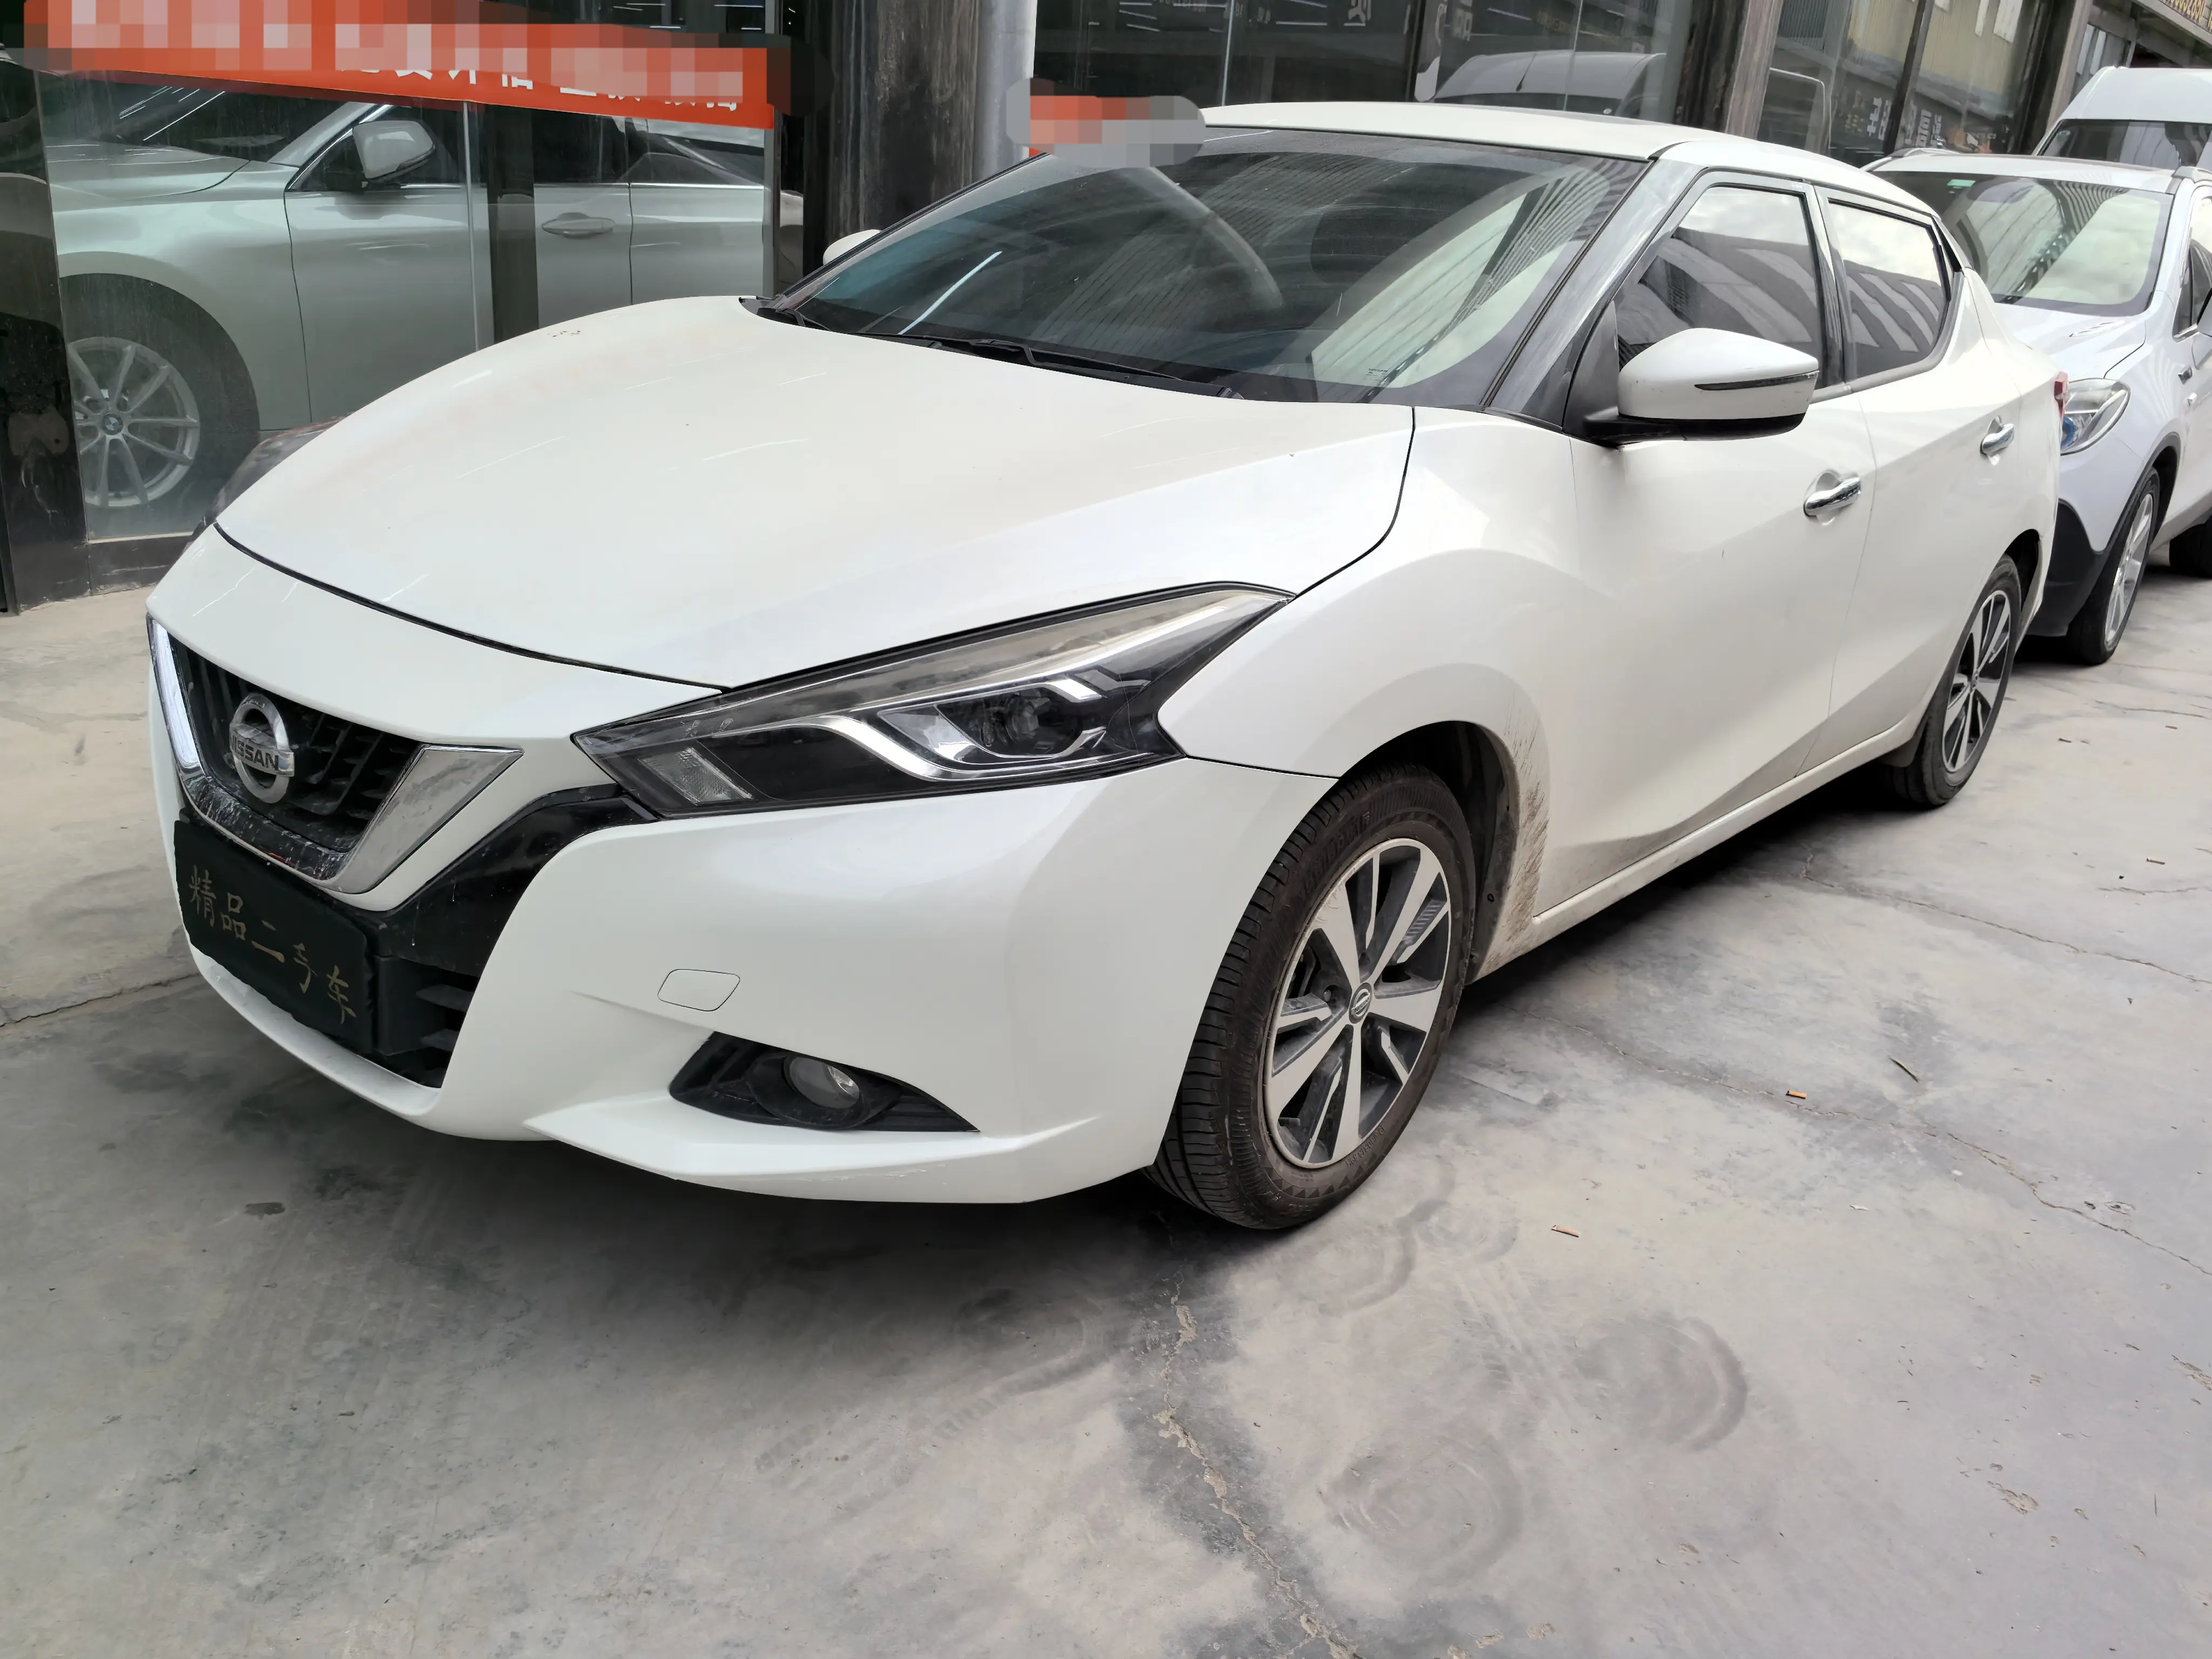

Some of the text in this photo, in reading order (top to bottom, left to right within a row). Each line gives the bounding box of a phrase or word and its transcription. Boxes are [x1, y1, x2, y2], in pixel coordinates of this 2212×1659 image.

[230, 734, 279, 772] NISSAN
[188, 864, 357, 1024] 精品二手车
